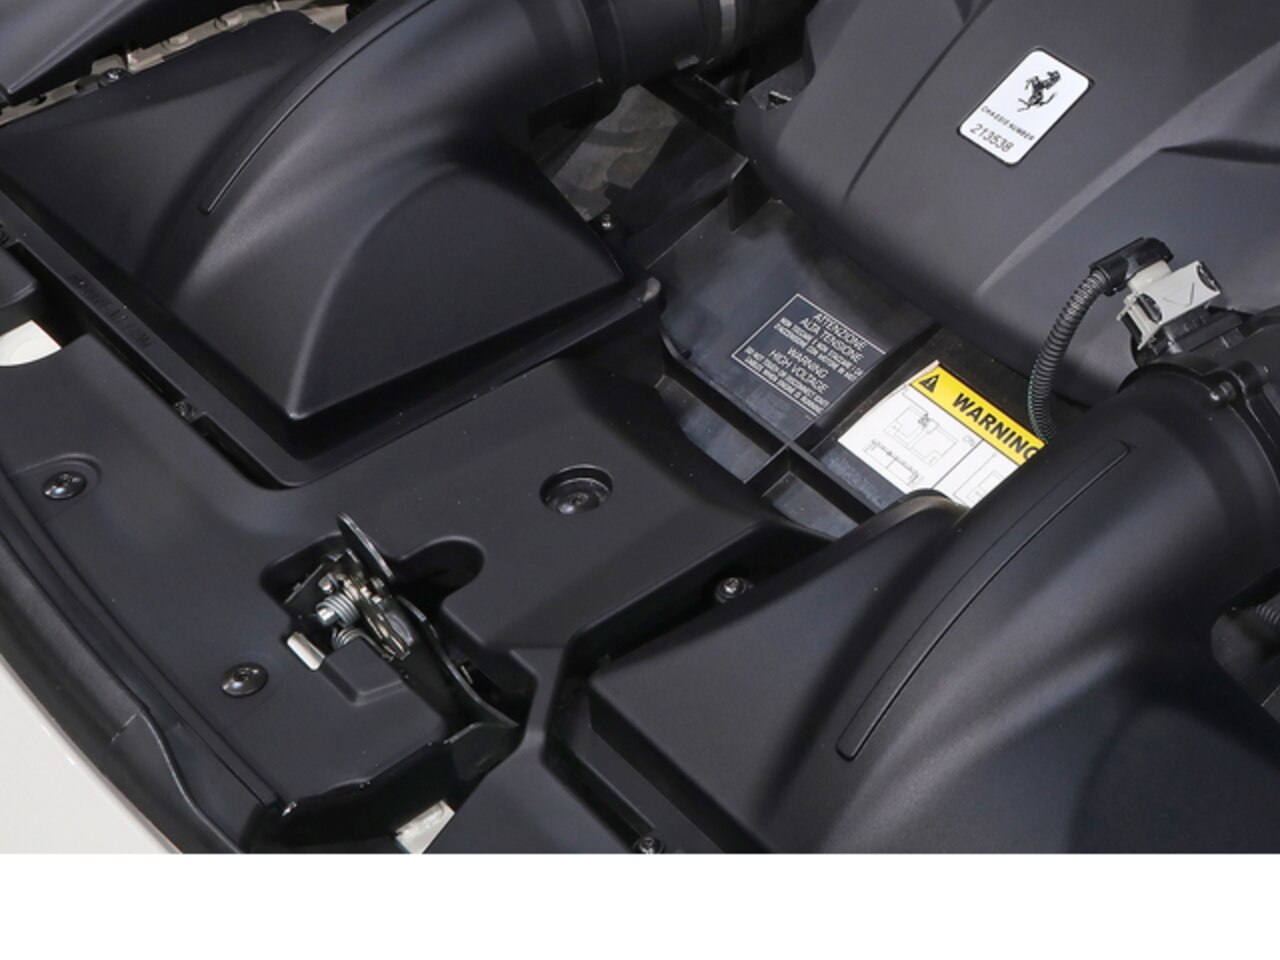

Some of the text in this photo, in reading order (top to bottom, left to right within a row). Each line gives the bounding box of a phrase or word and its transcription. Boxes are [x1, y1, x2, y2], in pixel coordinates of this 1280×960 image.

[800, 318, 863, 362] ALTA TENSIONE
[813, 312, 866, 350] ATTENZIONE
[769, 350, 828, 392] HIGH VOLTAGE
[785, 346, 828, 377] WARNING
